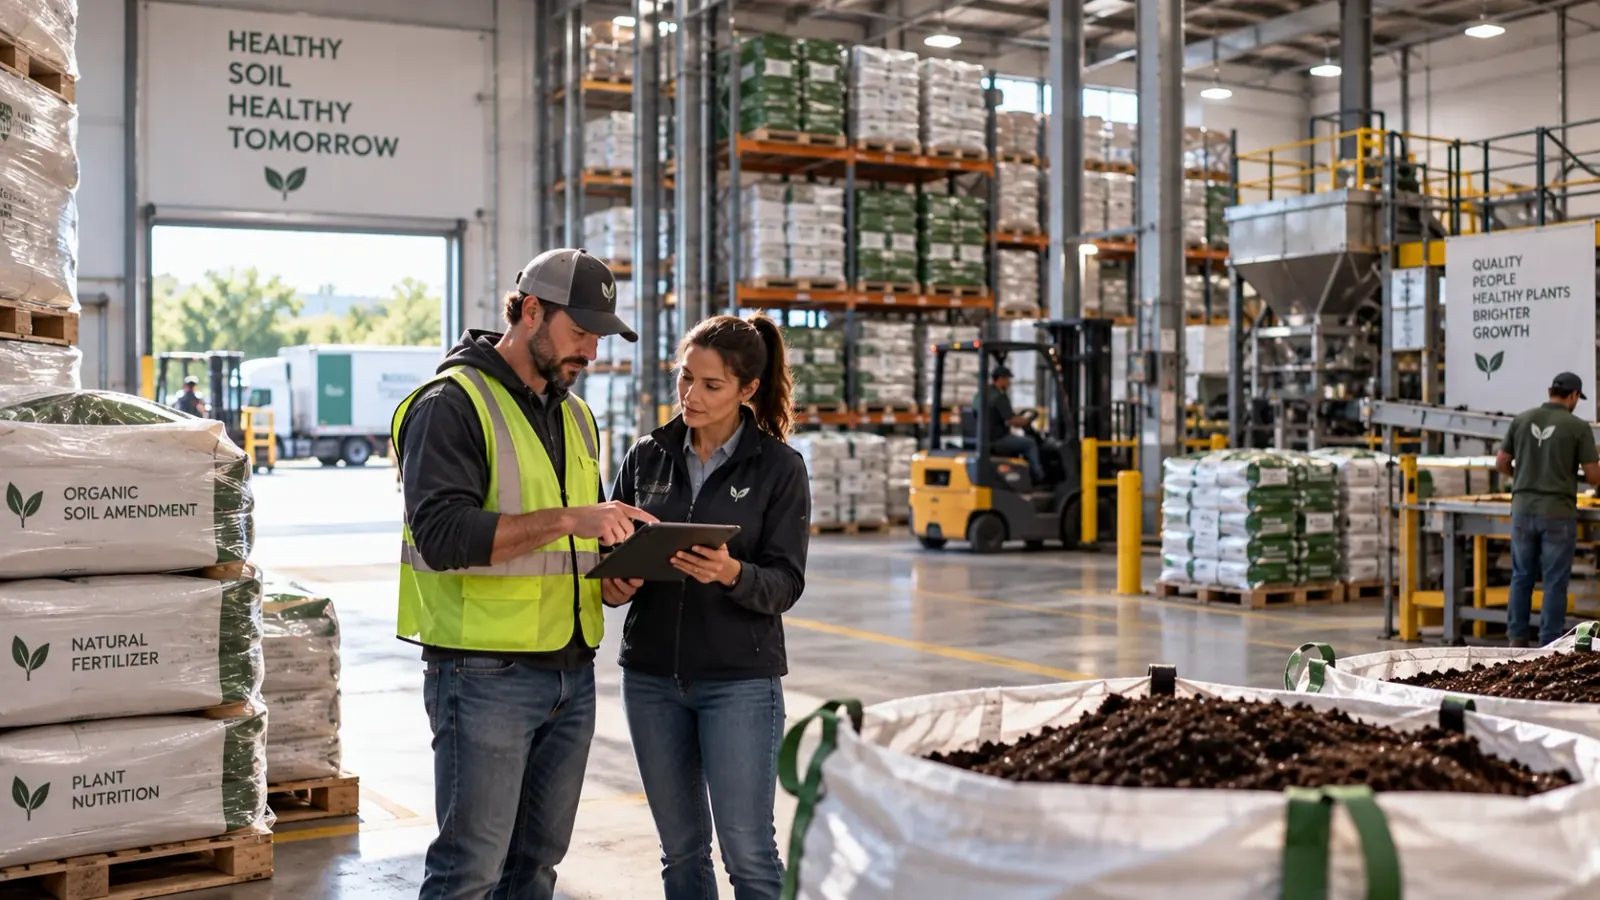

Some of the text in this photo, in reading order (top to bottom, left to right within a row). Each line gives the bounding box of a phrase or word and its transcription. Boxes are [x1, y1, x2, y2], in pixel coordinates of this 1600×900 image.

[228, 29, 343, 60] HEALTHY
[228, 61, 292, 88] SOIL
[228, 94, 352, 123] HEALTHY
[227, 126, 399, 158] TOMORROW
[1472, 255, 1523, 272] QUALITY
[1472, 273, 1517, 288] PEOPLE
[1472, 286, 1571, 304] HEALTHY PLANTS
[1473, 306, 1531, 322] BRIGHTER
[1473, 324, 1530, 340] GROWTH
[63, 485, 139, 501] ORGANIC
[63, 503, 198, 521] SOIL AMENDMENT
[72, 633, 148, 652] NATURAL
[72, 651, 159, 672] FERTILIZER
[72, 769, 126, 790] PLANT
[72, 785, 160, 810] NUTRITION
